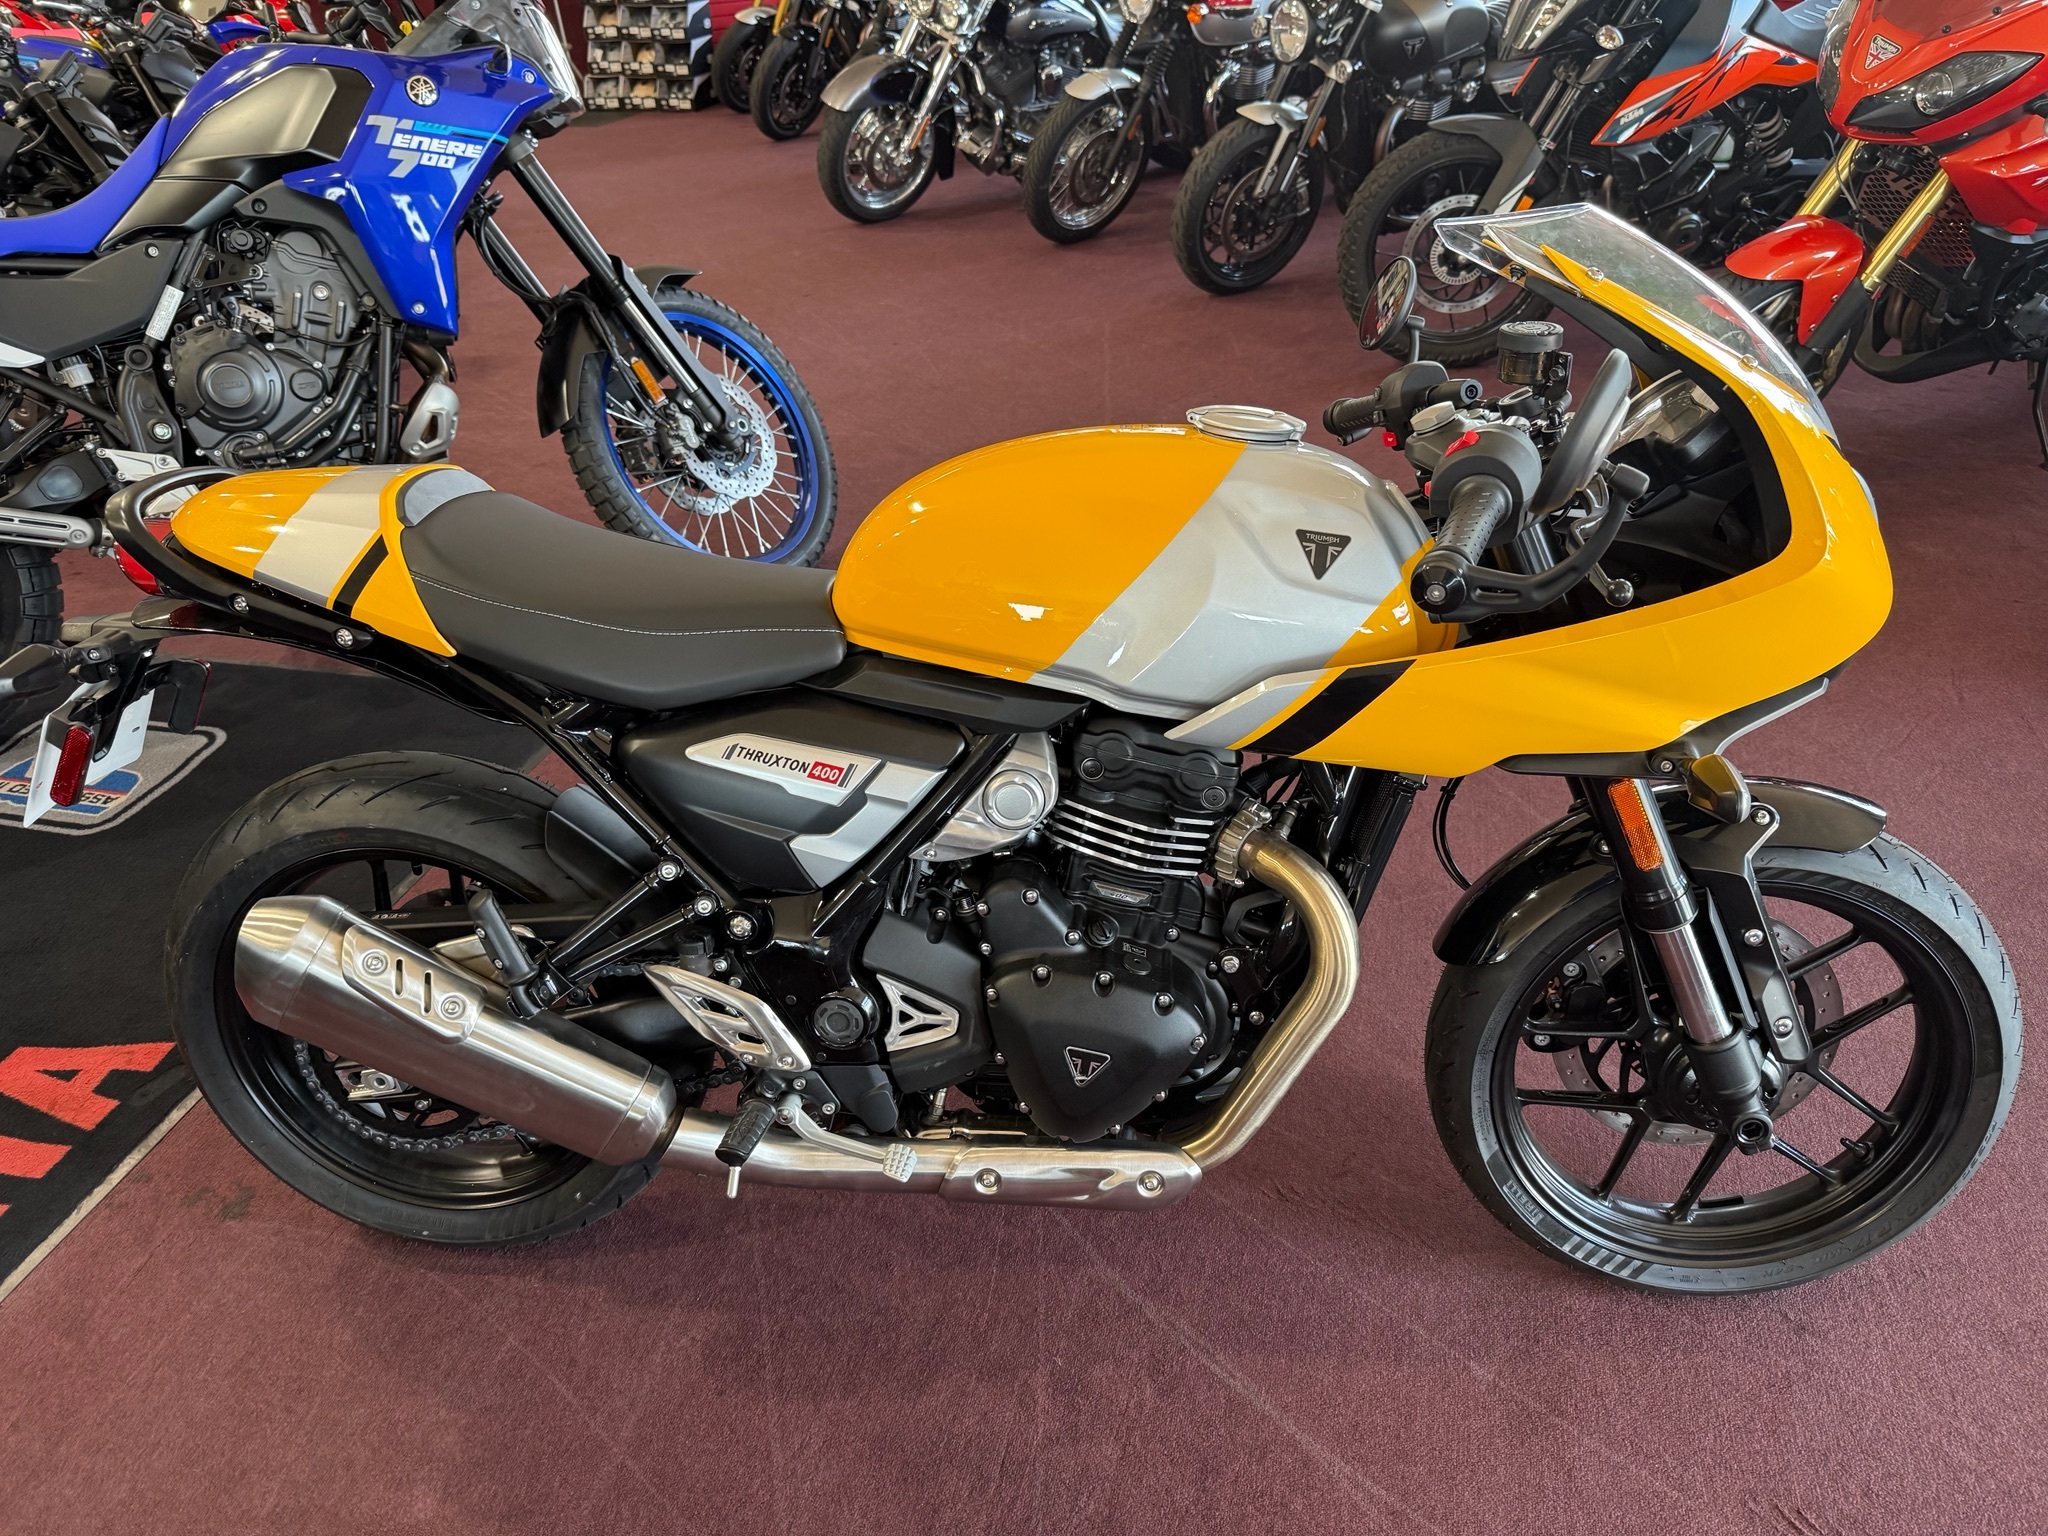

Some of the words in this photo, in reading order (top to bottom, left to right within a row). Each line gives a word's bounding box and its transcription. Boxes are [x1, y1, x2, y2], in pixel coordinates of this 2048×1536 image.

[1874, 36, 1899, 54] TRIUMPH
[1620, 107, 1644, 126] KTM
[388, 147, 456, 178] 700
[1305, 532, 1340, 544] TRIUMPH
[736, 746, 811, 773] THRUXTON
[811, 766, 839, 781] 400
[1502, 1180, 1545, 1226] PIRELLI
